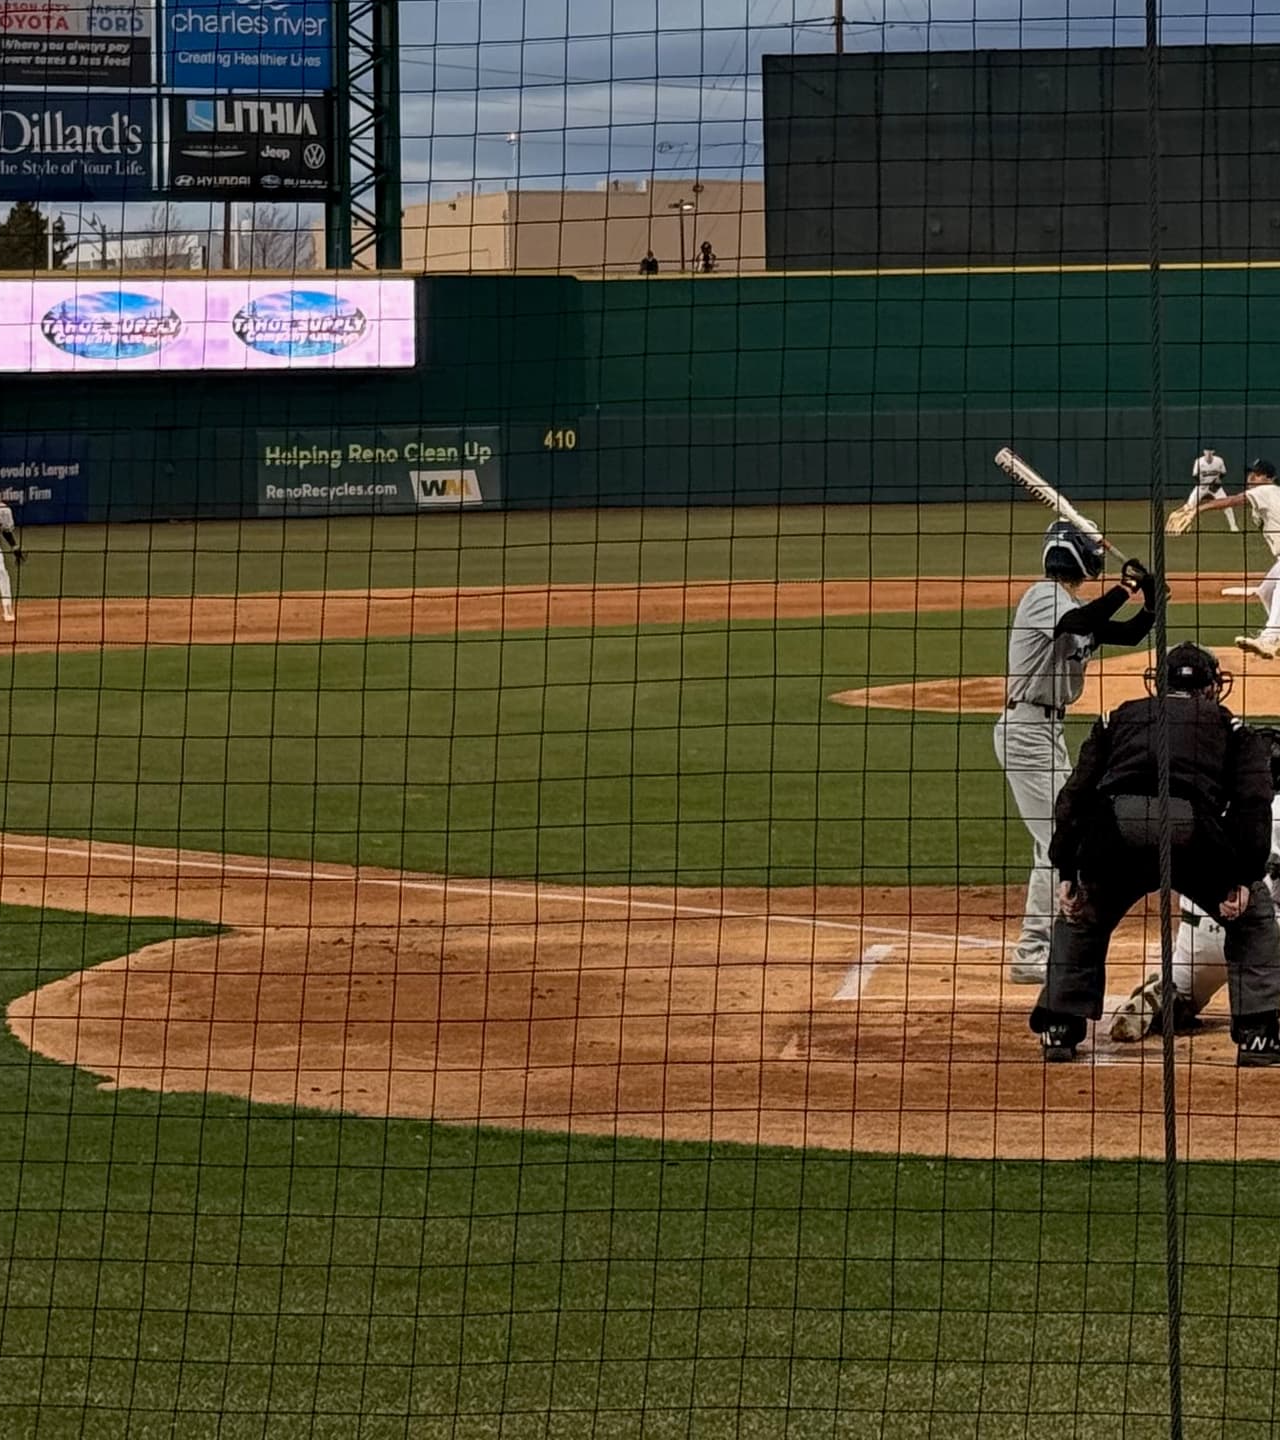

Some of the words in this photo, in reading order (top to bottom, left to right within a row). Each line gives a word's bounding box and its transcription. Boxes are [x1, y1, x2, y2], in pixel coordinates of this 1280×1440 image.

[87, 16, 144, 32] FORD
[171, 8, 269, 35] charles
[274, 10, 327, 37] river
[2, 38, 40, 50] Where
[42, 40, 64, 53] you
[66, 40, 106, 53] always
[108, 41, 131, 54] pay
[178, 51, 231, 68] Creating
[234, 52, 288, 66] Healthier
[290, 52, 322, 67] Lives
[216, 100, 318, 135] LITHIA
[261, 145, 291, 160] Jeep
[22, 160, 58, 179] Style
[61, 160, 76, 175] of
[81, 160, 117, 175] Your
[119, 161, 146, 176] Life.
[197, 175, 251, 187] HYUNDAI
[110, 317, 180, 335] SUPPLY
[296, 316, 365, 333] SUPPLY
[544, 429, 576, 449] 410
[265, 445, 341, 469] Helping
[349, 444, 399, 464] Reno
[404, 442, 458, 464] Clean
[464, 442, 492, 465] Up
[42, 462, 80, 480] Largest
[29, 486, 51, 500] Firm
[266, 482, 397, 500] RenoRecycles.com
[421, 478, 473, 496] WM
